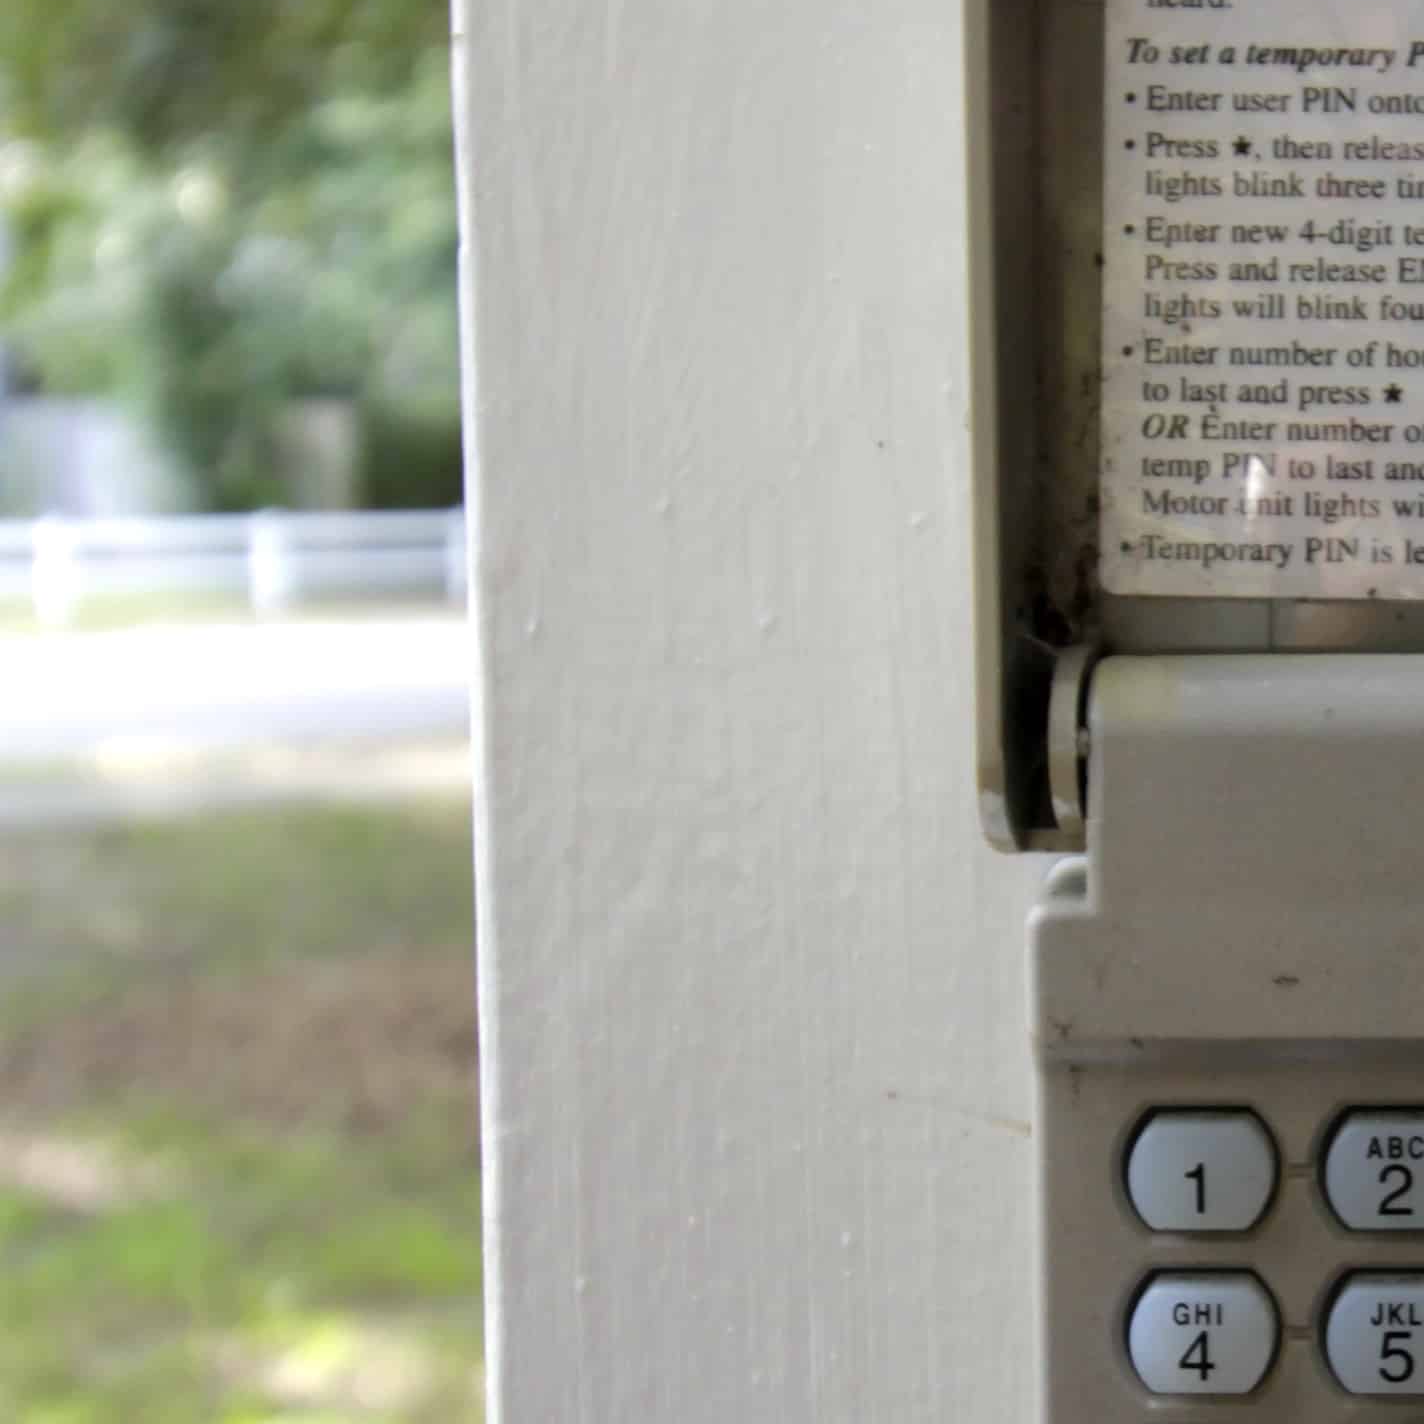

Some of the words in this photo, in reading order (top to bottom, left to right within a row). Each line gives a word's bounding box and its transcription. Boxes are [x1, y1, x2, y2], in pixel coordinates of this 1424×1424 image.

[1127, 37, 1158, 65] To
[1170, 40, 1208, 66] set
[1247, 42, 1395, 73] temporary
[1145, 85, 1220, 113] Enter
[1232, 93, 1291, 114] user
[1301, 87, 1357, 114] PIN
[1145, 131, 1218, 159] Press
[1272, 133, 1333, 161] then
[1144, 170, 1221, 204] lights
[1233, 171, 1305, 199] blink
[1316, 172, 1386, 200] three
[1144, 216, 1220, 244] Enter
[1231, 224, 1290, 245] new
[1299, 218, 1394, 252] 4-digit
[1144, 254, 1218, 282] Press
[1229, 255, 1278, 283] and
[1290, 256, 1386, 284] release
[1143, 292, 1221, 325] lights
[1232, 293, 1286, 321] will
[1296, 294, 1366, 322] blink
[1143, 338, 1219, 366] Enter
[1229, 339, 1339, 367] number
[1350, 341, 1378, 368] of
[1142, 378, 1170, 404] to
[1180, 377, 1227, 404] last
[1238, 377, 1286, 405] and
[1298, 385, 1371, 413] press
[1141, 413, 1188, 441] OR
[1201, 414, 1276, 442] Enter
[1287, 416, 1395, 444] number
[1141, 454, 1211, 485] temp
[1287, 456, 1314, 481] to
[1327, 454, 1373, 482] last
[1142, 489, 1227, 516] Motor
[1305, 491, 1380, 524] lights
[1143, 535, 1293, 568] Temporary
[1304, 536, 1359, 564] PIN
[1367, 1135, 1424, 1160] ABC
[1185, 1163, 1206, 1214] 1
[1378, 1163, 1414, 1216] 2
[1173, 1302, 1223, 1326] GHI
[1371, 1303, 1423, 1327] JKL
[1179, 1330, 1216, 1382] 4
[1379, 1331, 1415, 1383] 5
